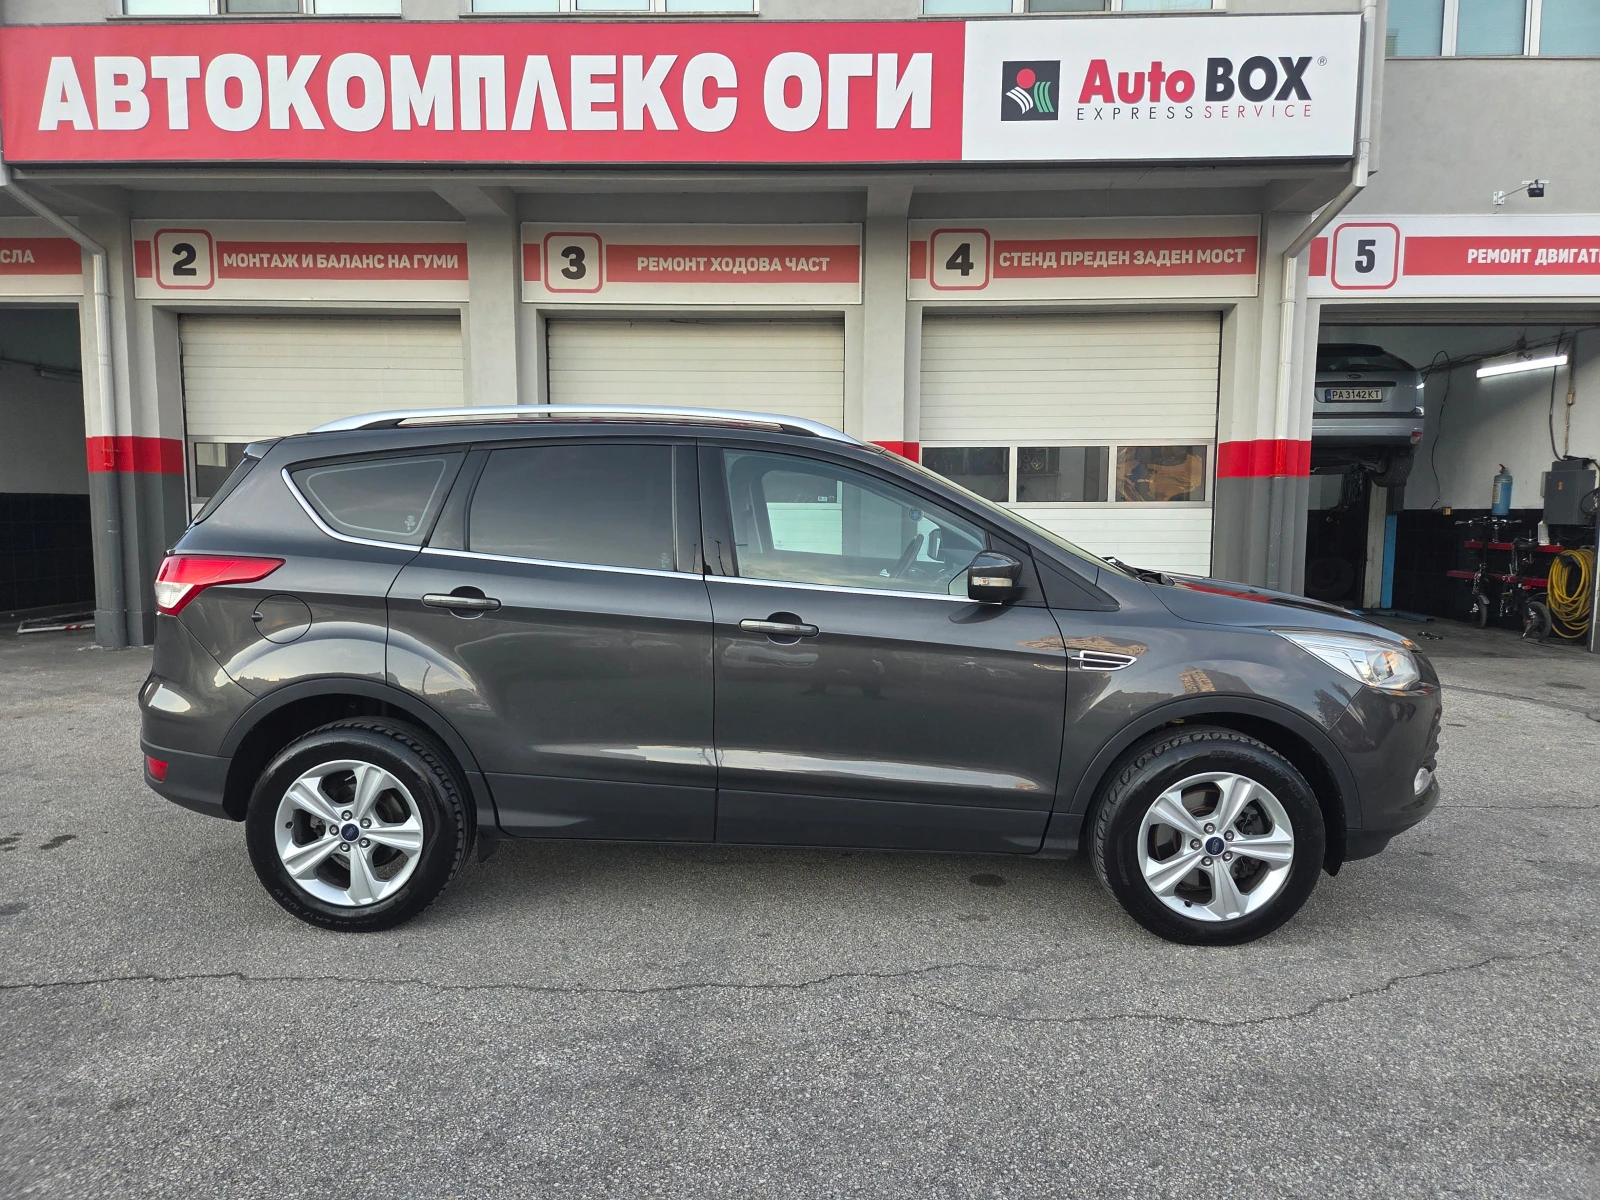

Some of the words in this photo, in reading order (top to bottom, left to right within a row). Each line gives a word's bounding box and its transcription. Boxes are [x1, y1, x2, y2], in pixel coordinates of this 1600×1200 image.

[38, 52, 739, 133] АВТОКОМПЛЕКС
[764, 51, 933, 133] ОГИ
[1078, 59, 1196, 104] Auto
[1204, 55, 1313, 103] BOX
[1076, 106, 1194, 121] EXPRESS
[1204, 104, 1313, 119] SERVICE
[171, 243, 198, 277] 2
[223, 253, 299, 268] МОНТАЖ
[301, 254, 314, 268] И
[316, 254, 385, 270] БАЛАНС
[388, 255, 411, 269] НА
[413, 255, 459, 269] ГУМИ
[560, 245, 587, 281] 3
[636, 257, 708, 272] РЕМОНТ
[710, 257, 783, 275] ХОДОВА
[785, 257, 831, 272] ЧАСТ
[945, 242, 975, 277] 4
[999, 252, 1058, 269] СТЕНД
[1060, 250, 1131, 268] ПРЕДЕН
[1132, 249, 1194, 267] ЗАДЕН
[1196, 248, 1246, 263] МОСТ
[1354, 239, 1377, 274] 5
[1467, 248, 1532, 264] РЕМОНТ
[1534, 248, 1600, 266] ДВИГАТ
